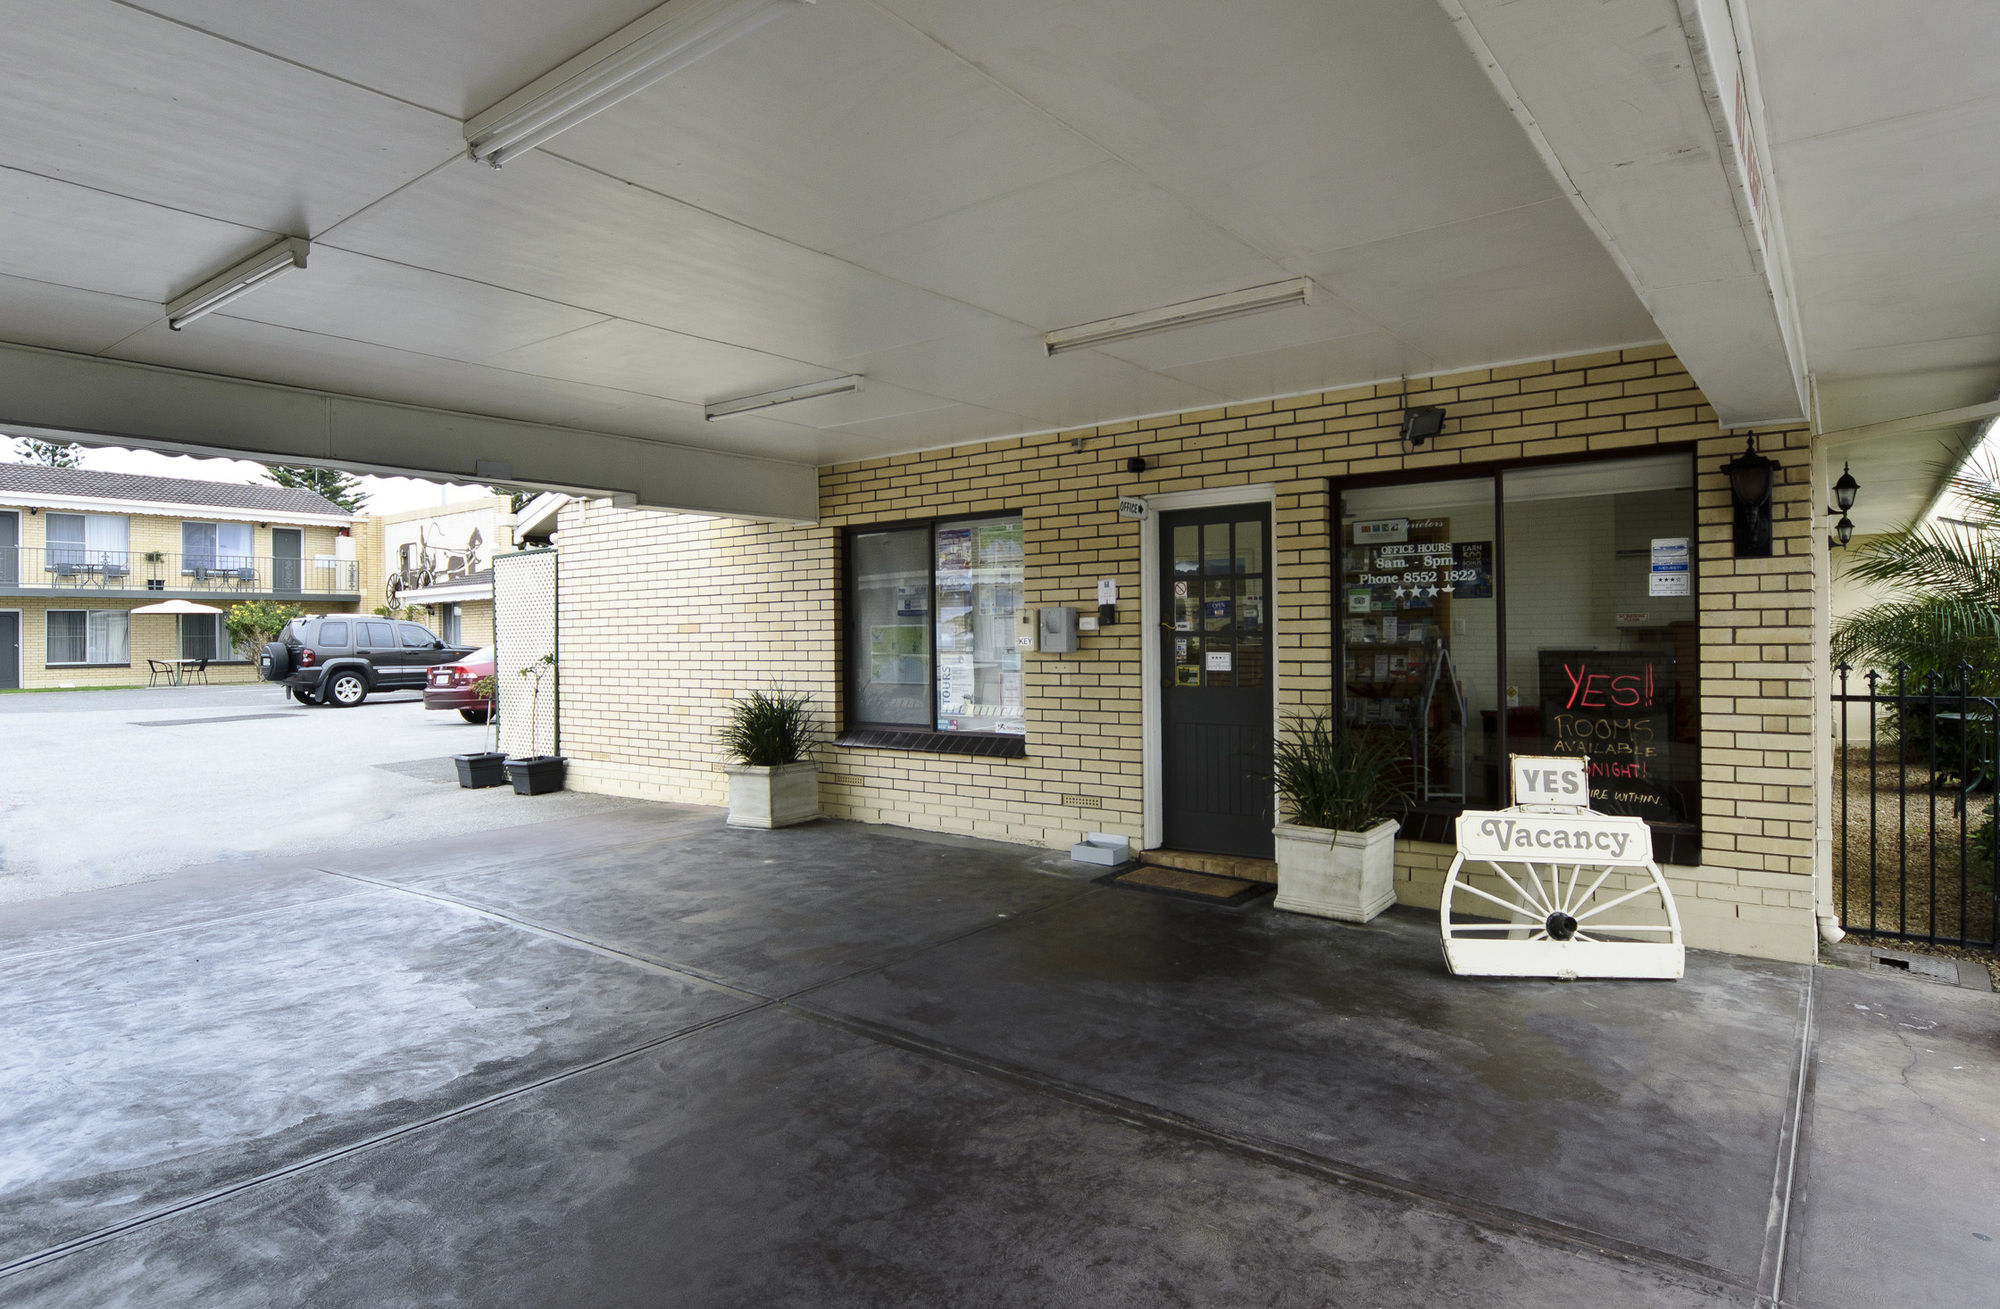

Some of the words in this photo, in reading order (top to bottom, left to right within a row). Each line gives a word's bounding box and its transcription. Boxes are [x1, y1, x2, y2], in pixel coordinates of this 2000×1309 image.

[1120, 501, 1138, 514] OFFICE
[1381, 545, 1415, 555] OFFICE
[1418, 543, 1452, 553] HOURS
[1376, 558, 1409, 569] 8am.
[1424, 555, 1458, 569] 8pm.
[1360, 574, 1399, 585] Phone
[1403, 572, 1438, 583] 8552
[1444, 569, 1477, 582] 1822
[1018, 637, 1032, 645] KEY
[942, 666, 951, 705] TOURS
[1563, 663, 1654, 710] YES!!
[1554, 713, 1654, 741] ROOMS
[1554, 739, 1657, 758] AVAILABLE
[1522, 769, 1580, 795] YES
[1481, 819, 1630, 858] Vacancy
